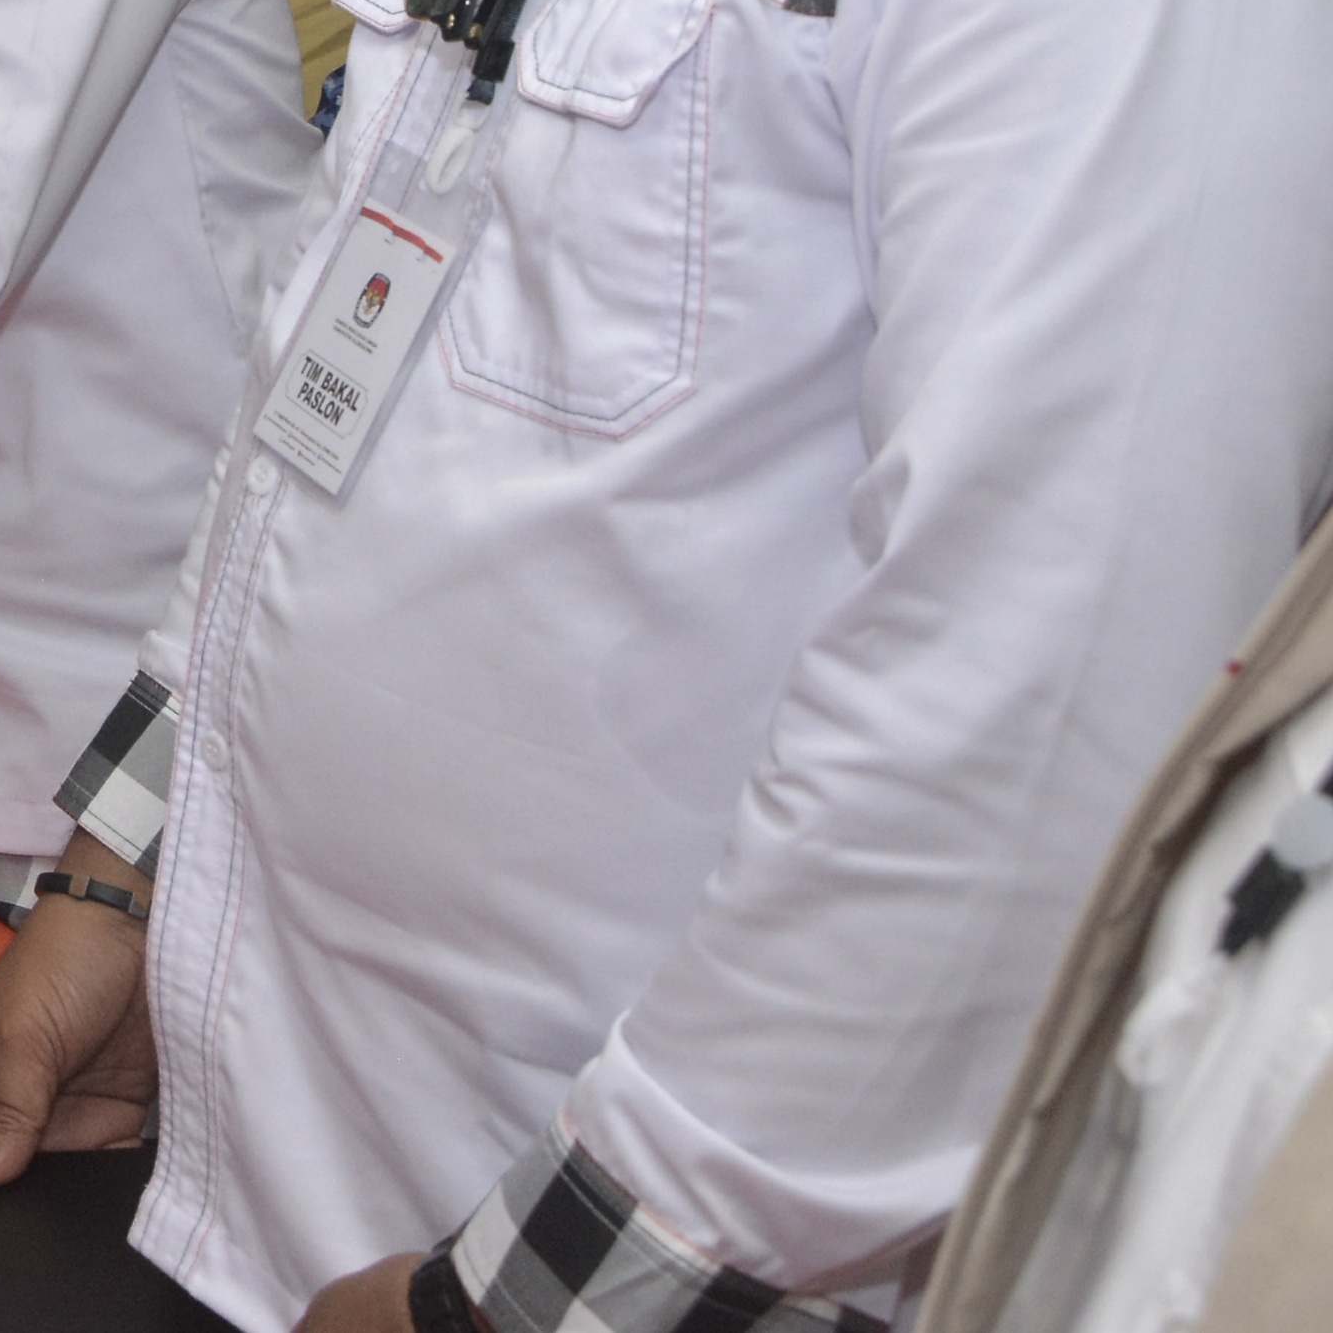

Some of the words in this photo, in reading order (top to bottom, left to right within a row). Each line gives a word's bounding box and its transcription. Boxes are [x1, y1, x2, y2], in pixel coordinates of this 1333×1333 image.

[296, 381, 345, 427] PASLON
[300, 356, 322, 382] TIM
[320, 371, 361, 412] BAKAL
